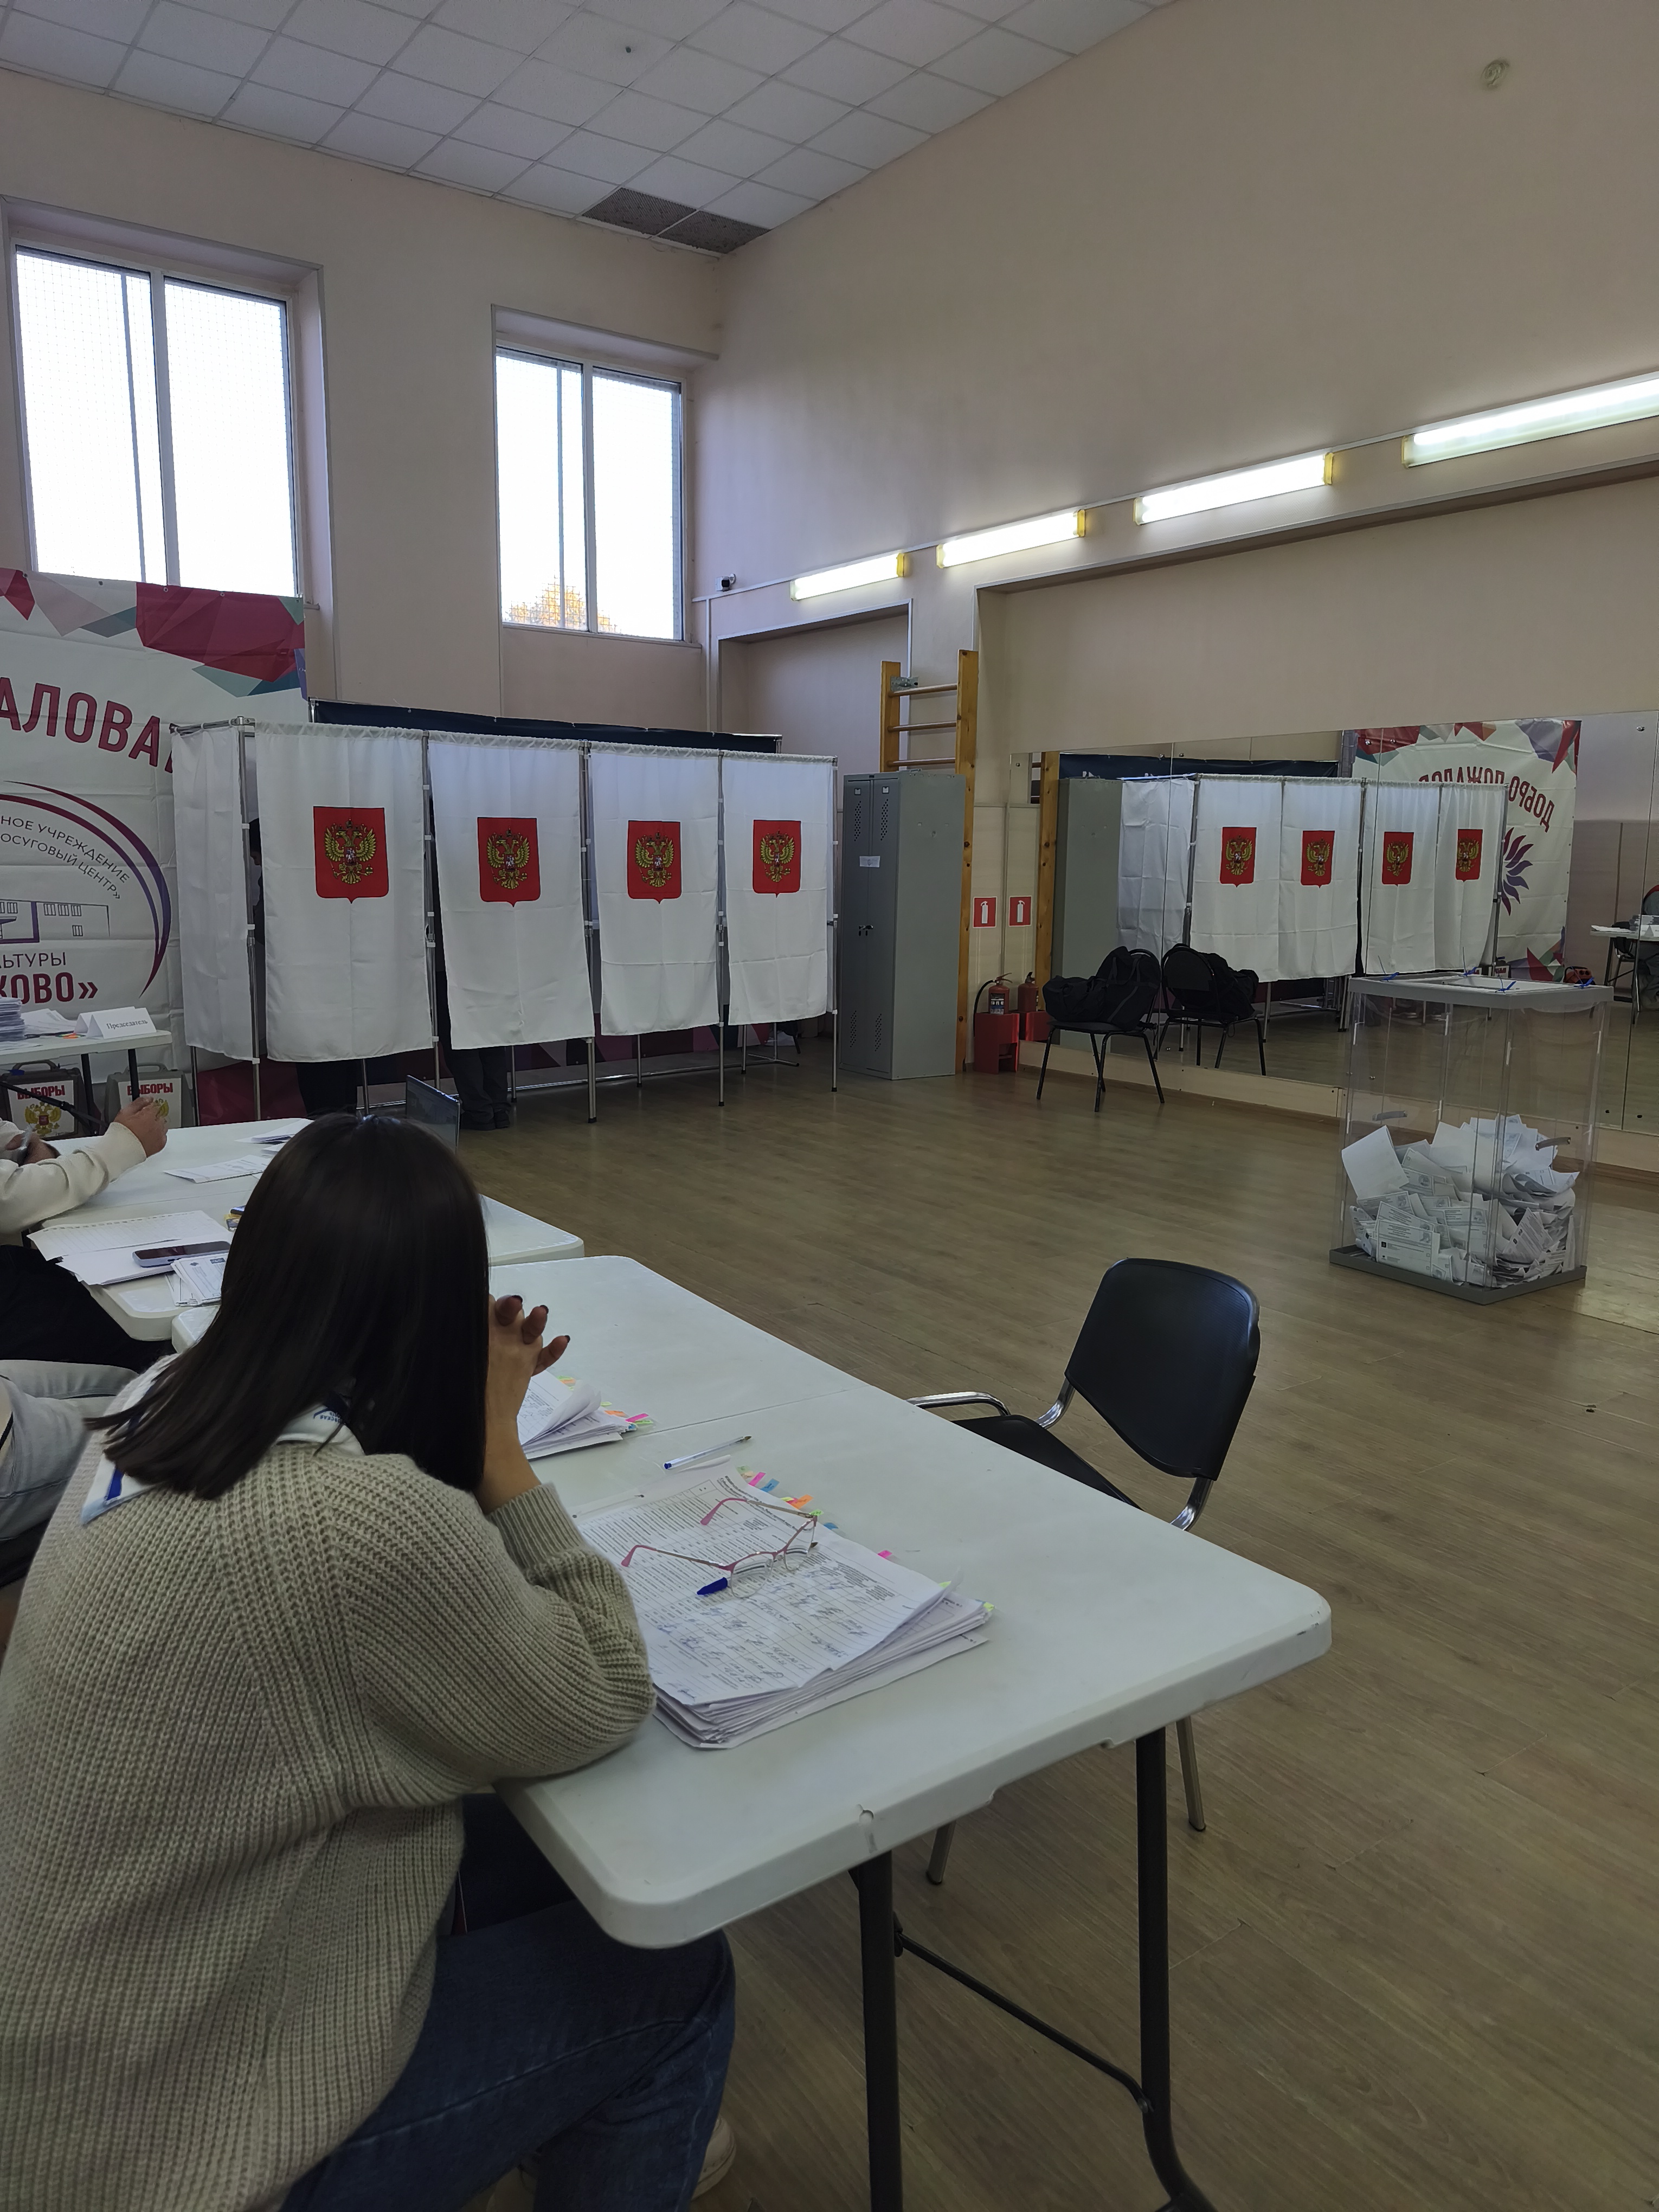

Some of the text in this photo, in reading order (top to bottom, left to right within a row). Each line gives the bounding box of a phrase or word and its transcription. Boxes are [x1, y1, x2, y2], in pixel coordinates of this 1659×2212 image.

[0, 677, 172, 773] АЛОВА
[1, 815, 130, 883] НОЕ УЧРЕЖДЕНИЕ
[1, 833, 120, 899] ОСУГОВЫЙ ЦЕНТР»
[0, 951, 66, 969] ЬТУРЫ
[106, 1019, 149, 1030] Председатель
